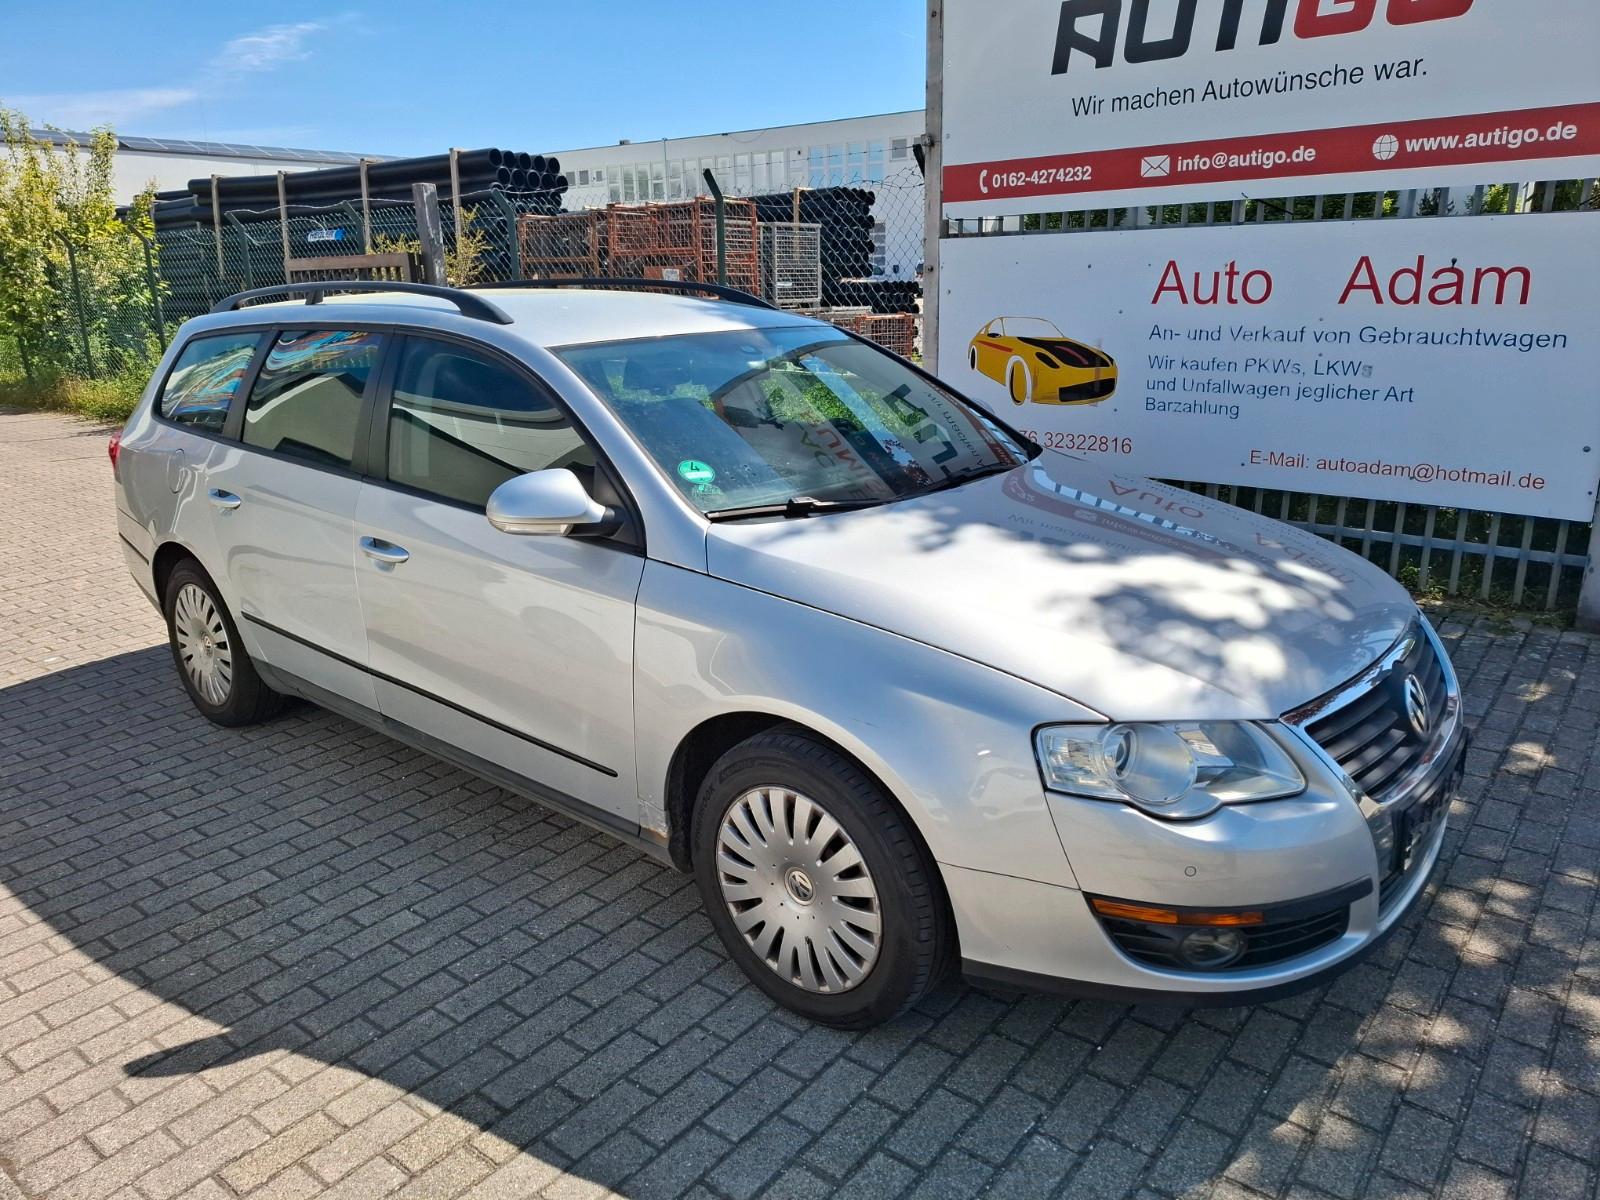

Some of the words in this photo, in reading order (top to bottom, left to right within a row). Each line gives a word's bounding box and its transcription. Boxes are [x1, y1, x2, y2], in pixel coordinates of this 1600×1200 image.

[1051, 0, 1475, 75] AUTI
[1072, 96, 1105, 118] Wir
[1111, 86, 1195, 113] machen
[1202, 64, 1364, 101] Autowünsche
[1374, 57, 1428, 79] war.
[1405, 121, 1578, 153] www.autigo.de
[1177, 147, 1317, 172] info@autigo.de
[992, 165, 1092, 188] 0162-4274232
[1151, 260, 1273, 305] Auto
[1338, 255, 1531, 305] Adam
[1149, 324, 1181, 341] An-
[1187, 326, 1222, 342] und
[1230, 325, 1306, 343] Verkauf
[1313, 329, 1350, 344] von
[1359, 326, 1567, 352] Gebrauchtwagen
[1148, 355, 1175, 370] Wir
[1180, 357, 1237, 372] kaufen
[1245, 358, 1306, 377] PKWs,
[1146, 377, 1176, 391] und
[1183, 378, 1290, 400] Unfallwagen
[1295, 382, 1380, 402] jeglicher
[1384, 386, 1414, 403] Art
[1145, 397, 1240, 420] Barzahlung
[1043, 431, 1132, 454] 32322816
[691, 461, 700, 472] 4
[1250, 450, 1310, 469] E-Mail:
[1316, 456, 1545, 490] autoadam@hotmail.de
